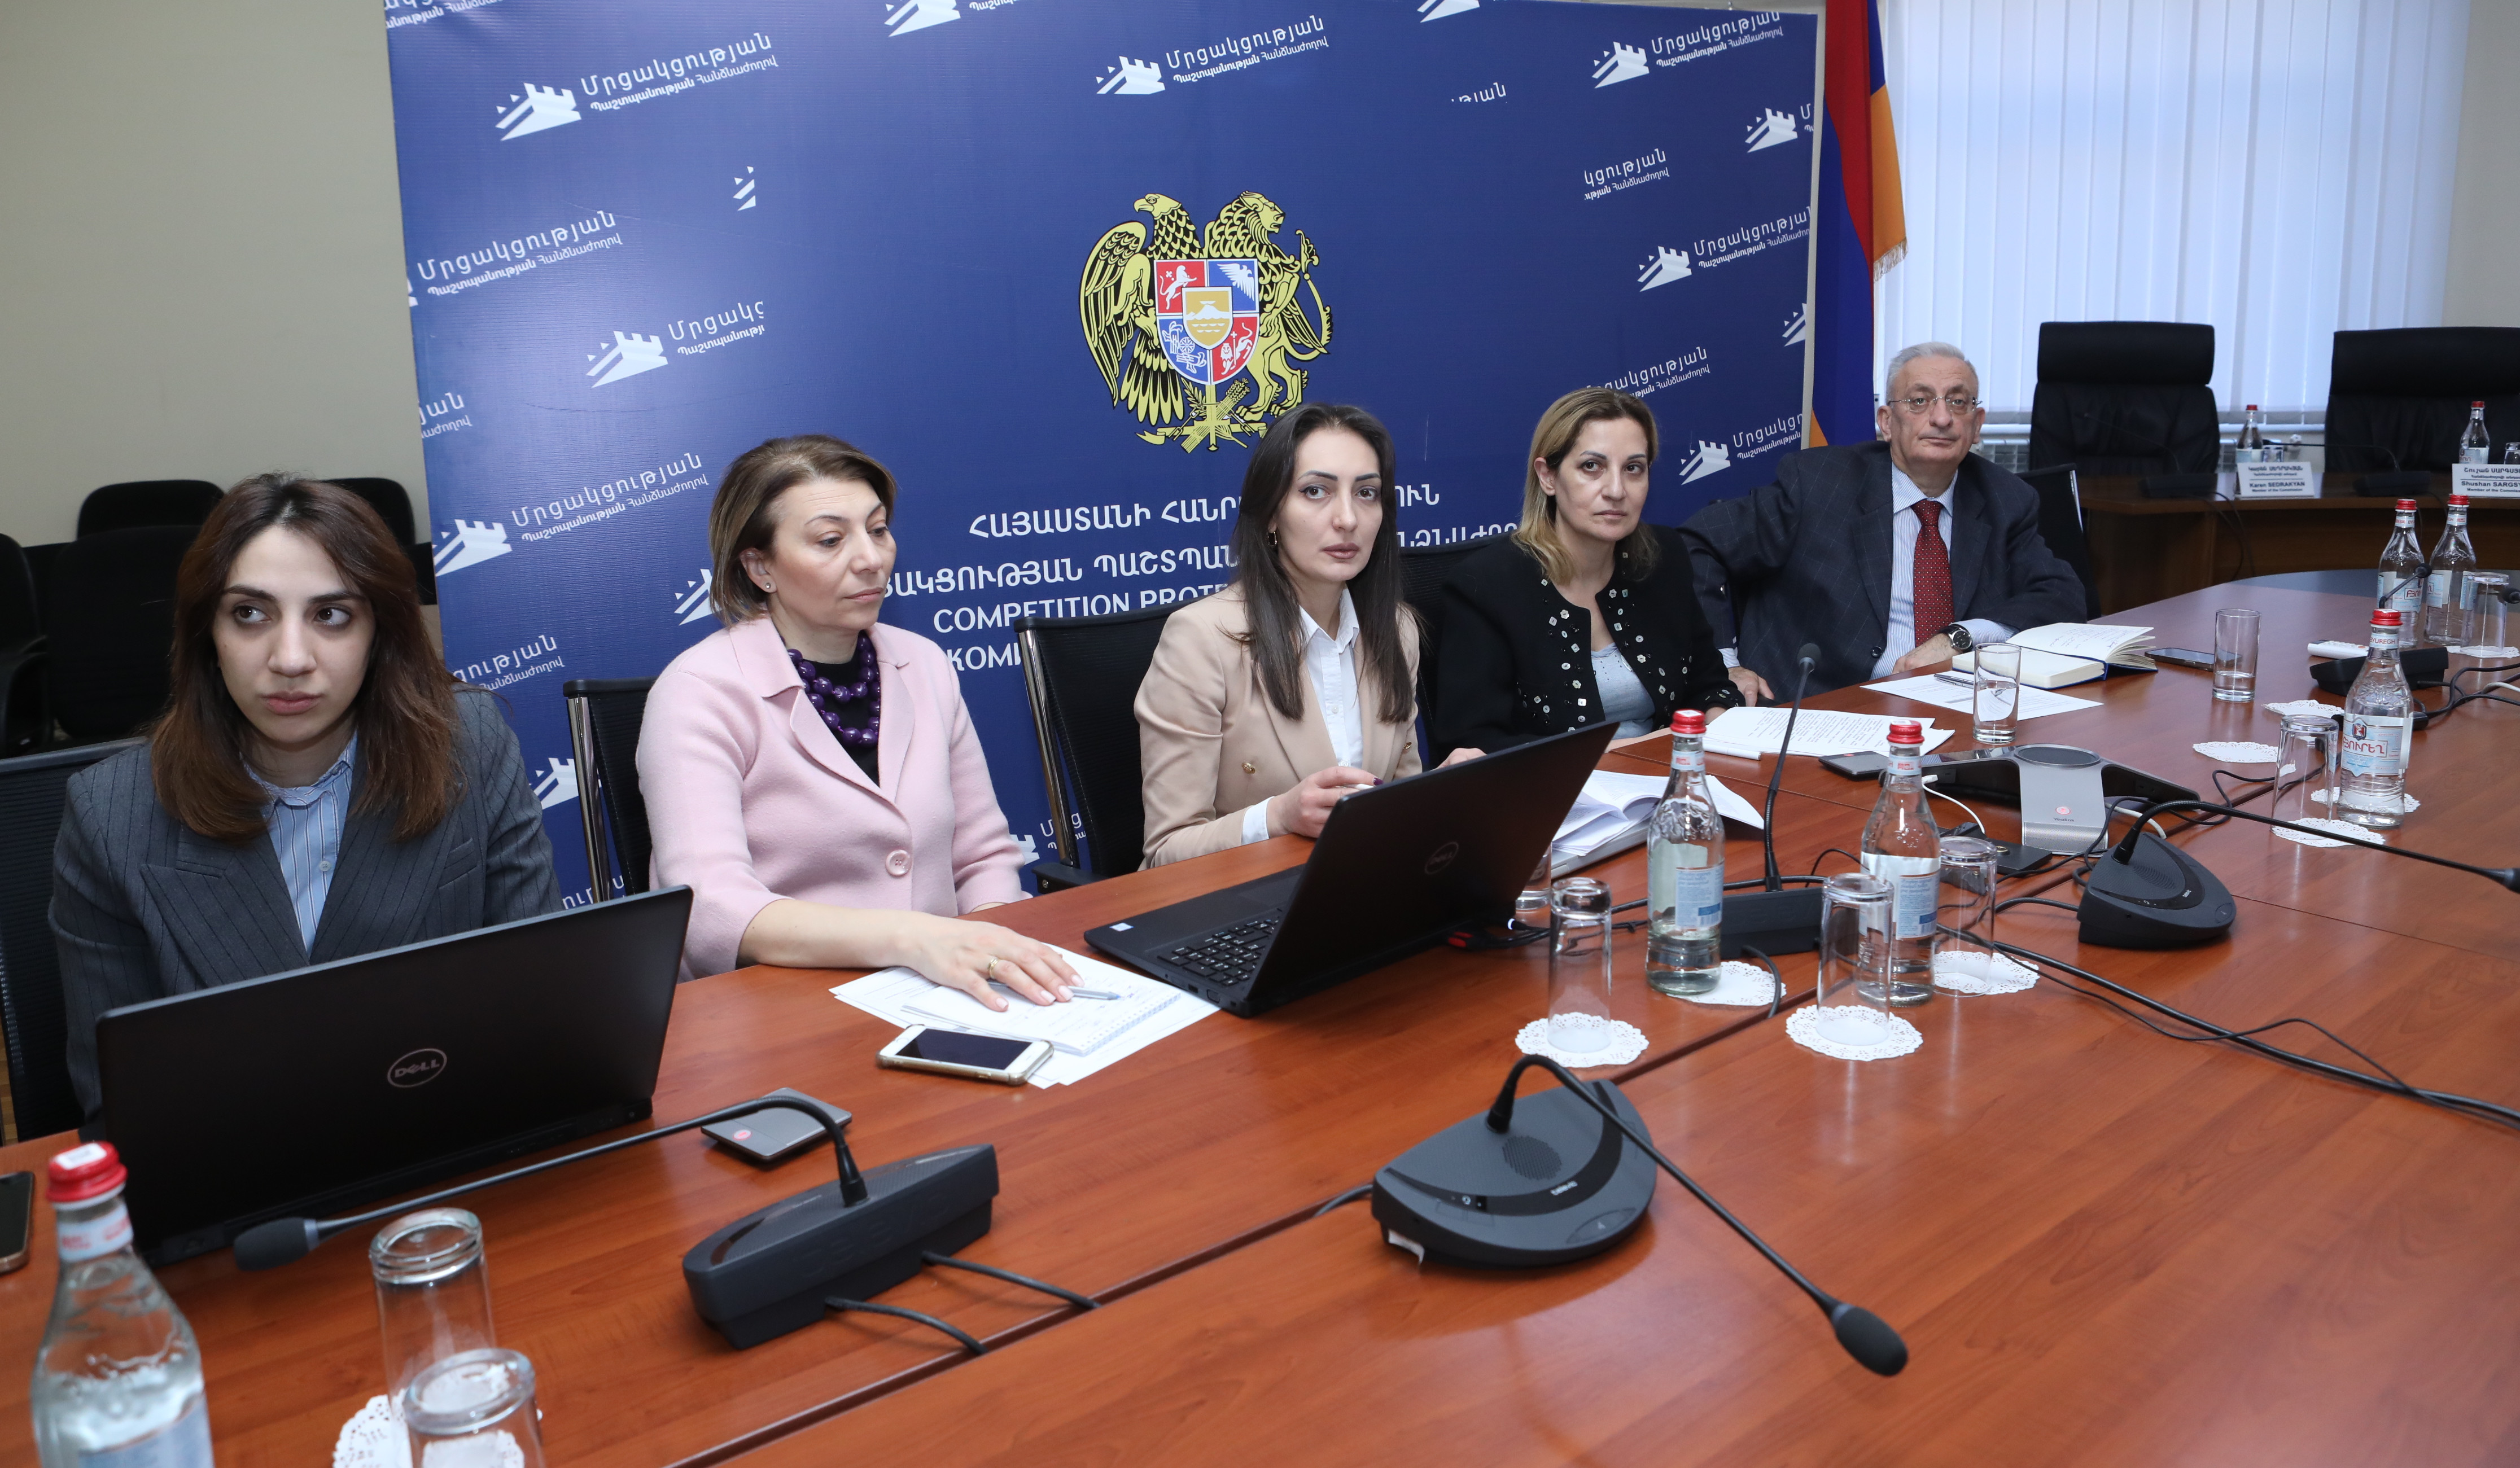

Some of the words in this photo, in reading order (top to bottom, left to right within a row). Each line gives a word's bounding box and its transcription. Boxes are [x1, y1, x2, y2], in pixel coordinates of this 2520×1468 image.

[1166, 15, 1323, 68] Մրցակցության
[1174, 51, 1259, 82] Պաշտպանության
[1261, 36, 1328, 60] Հանձնաժողով
[1656, 42, 1727, 67] Պաշտպանության
[1728, 27, 1784, 47] Հանձնաժողով
[581, 33, 772, 95] Մրցակցության
[589, 72, 694, 111] Պաշտպանության
[696, 55, 778, 85] Հանձնաժողով
[1612, 167, 1670, 190] Հանձնաժողով
[418, 211, 616, 279] Մրցակցության
[427, 253, 536, 295] Պաշտպանության
[537, 233, 623, 264] Հանձնաժողով
[1699, 242, 1766, 268] Պաշտպանության
[1656, 364, 1710, 389] Հանձնաժողով
[512, 453, 701, 526] Մրցակցության
[522, 502, 625, 541] Պաշտպանության
[627, 474, 708, 506] Հանձնաժողով
[969, 503, 1151, 538] ՀԱՅԱՍՏԱՆԻ
[884, 558, 1083, 598] ԱԿՑՈՒԹՅԱՆ
[934, 593, 1130, 633] COMPETITION
[395, 1059, 440, 1078] DELL
